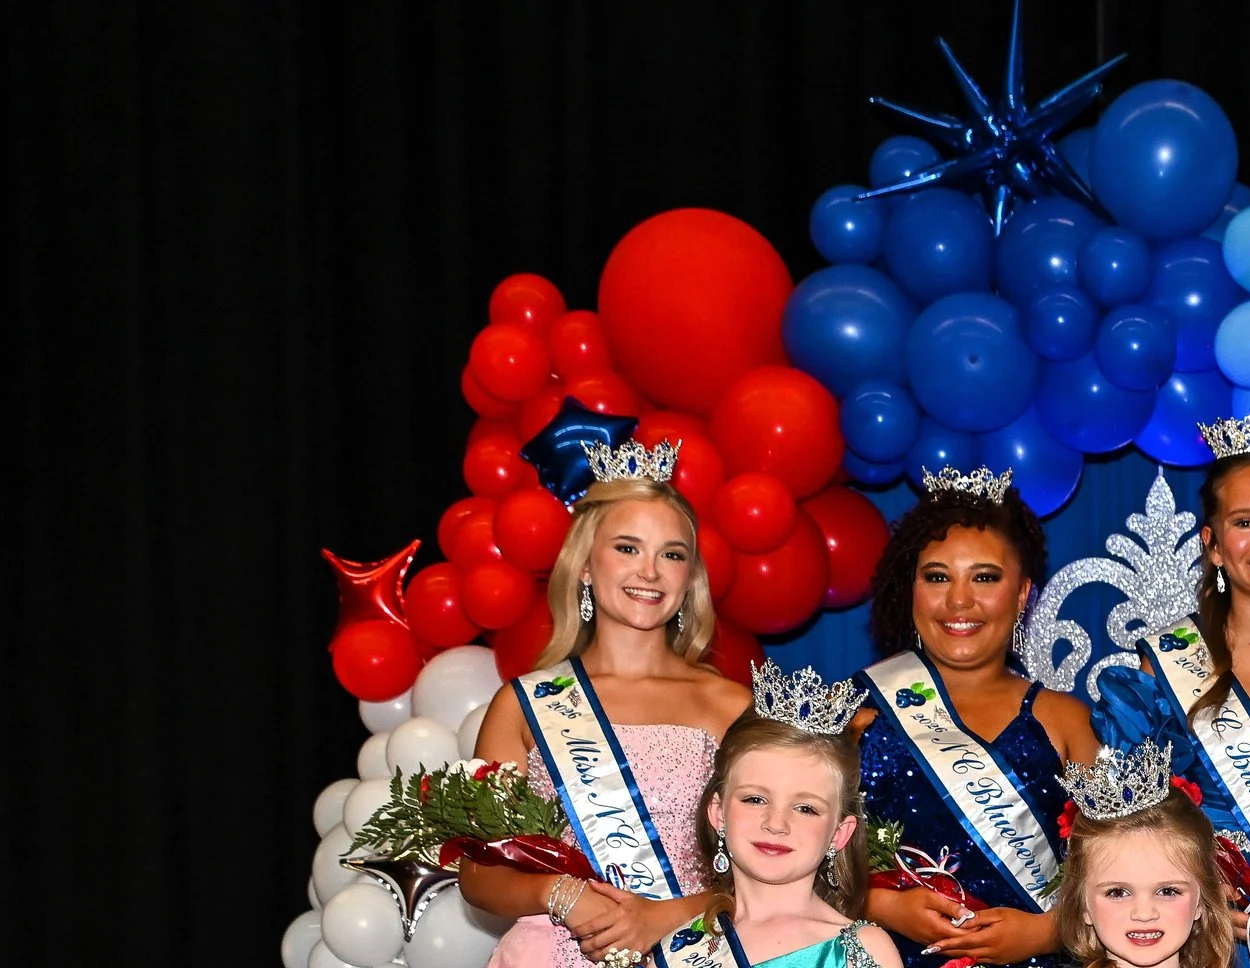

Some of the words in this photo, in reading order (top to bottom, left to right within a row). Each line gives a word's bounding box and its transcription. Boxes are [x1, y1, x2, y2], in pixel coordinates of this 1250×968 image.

[1173, 657, 1210, 678] 2026
[548, 700, 582, 720] 2026
[910, 712, 948, 734] 2026
[560, 728, 601, 787] Miss
[587, 792, 640, 849] NC
[931, 736, 986, 775] NC
[966, 777, 1049, 891] Blueberry
